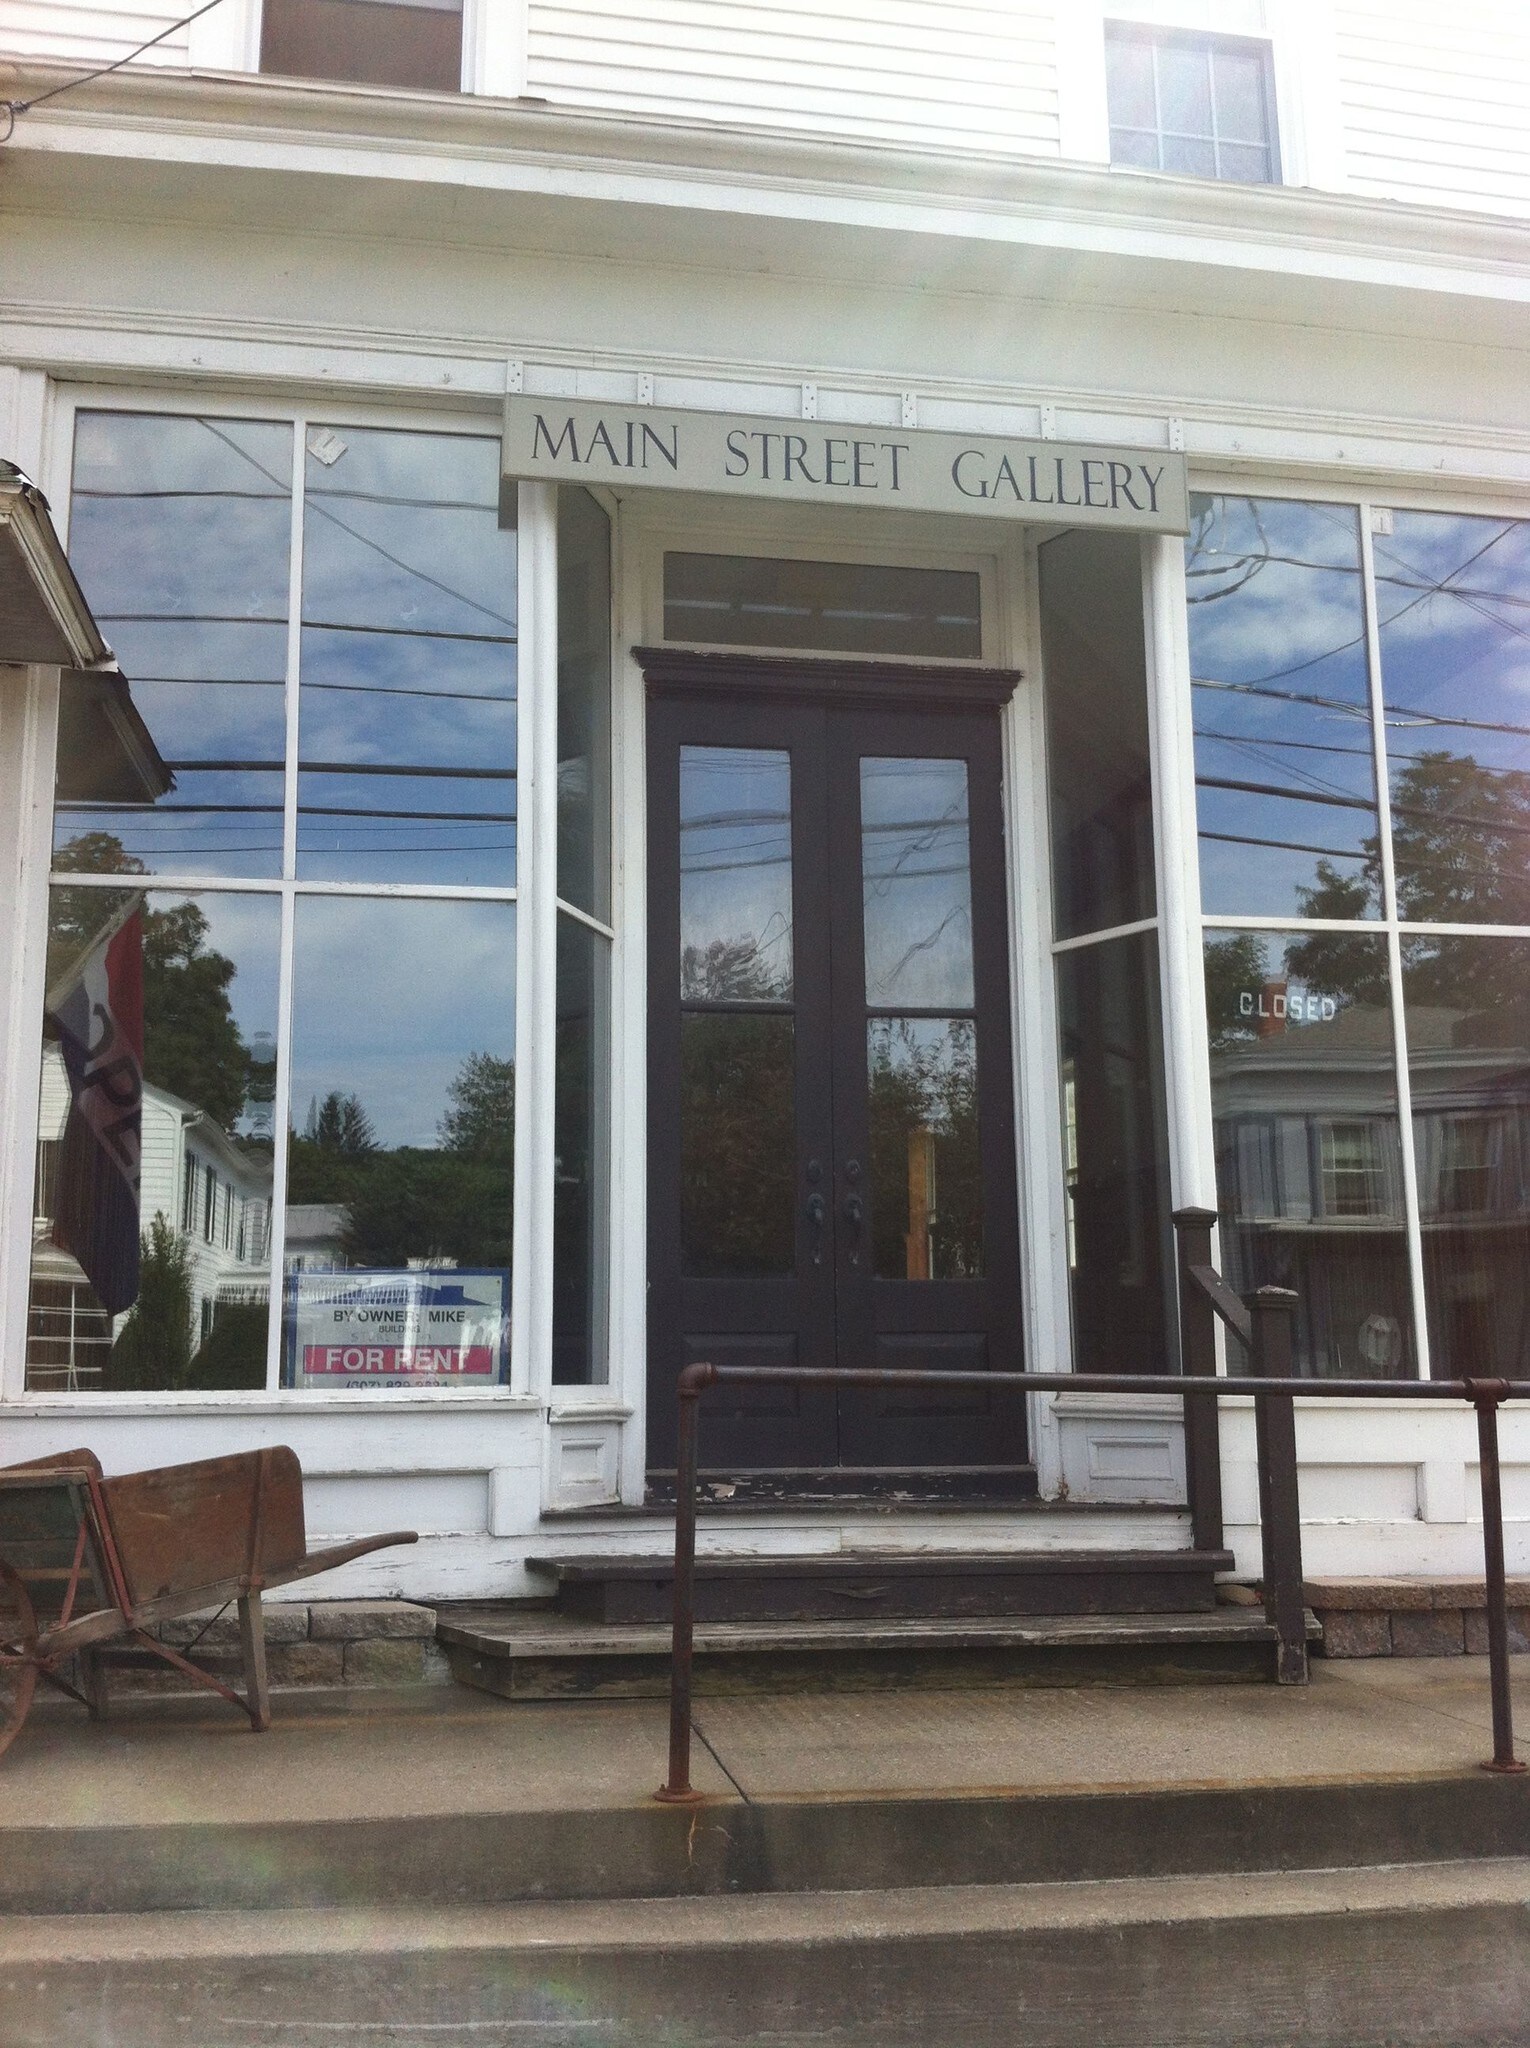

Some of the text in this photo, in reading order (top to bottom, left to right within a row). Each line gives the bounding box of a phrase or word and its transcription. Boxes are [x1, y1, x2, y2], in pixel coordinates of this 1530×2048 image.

[531, 414, 1165, 513] MAIN STREET GALLERY
[1240, 991, 1336, 1020] CLOSED
[333, 1310, 354, 1323] BY
[428, 1310, 466, 1323] MIKE
[378, 1325, 421, 1333] BUILDG
[325, 1348, 470, 1371] FOR RENT
